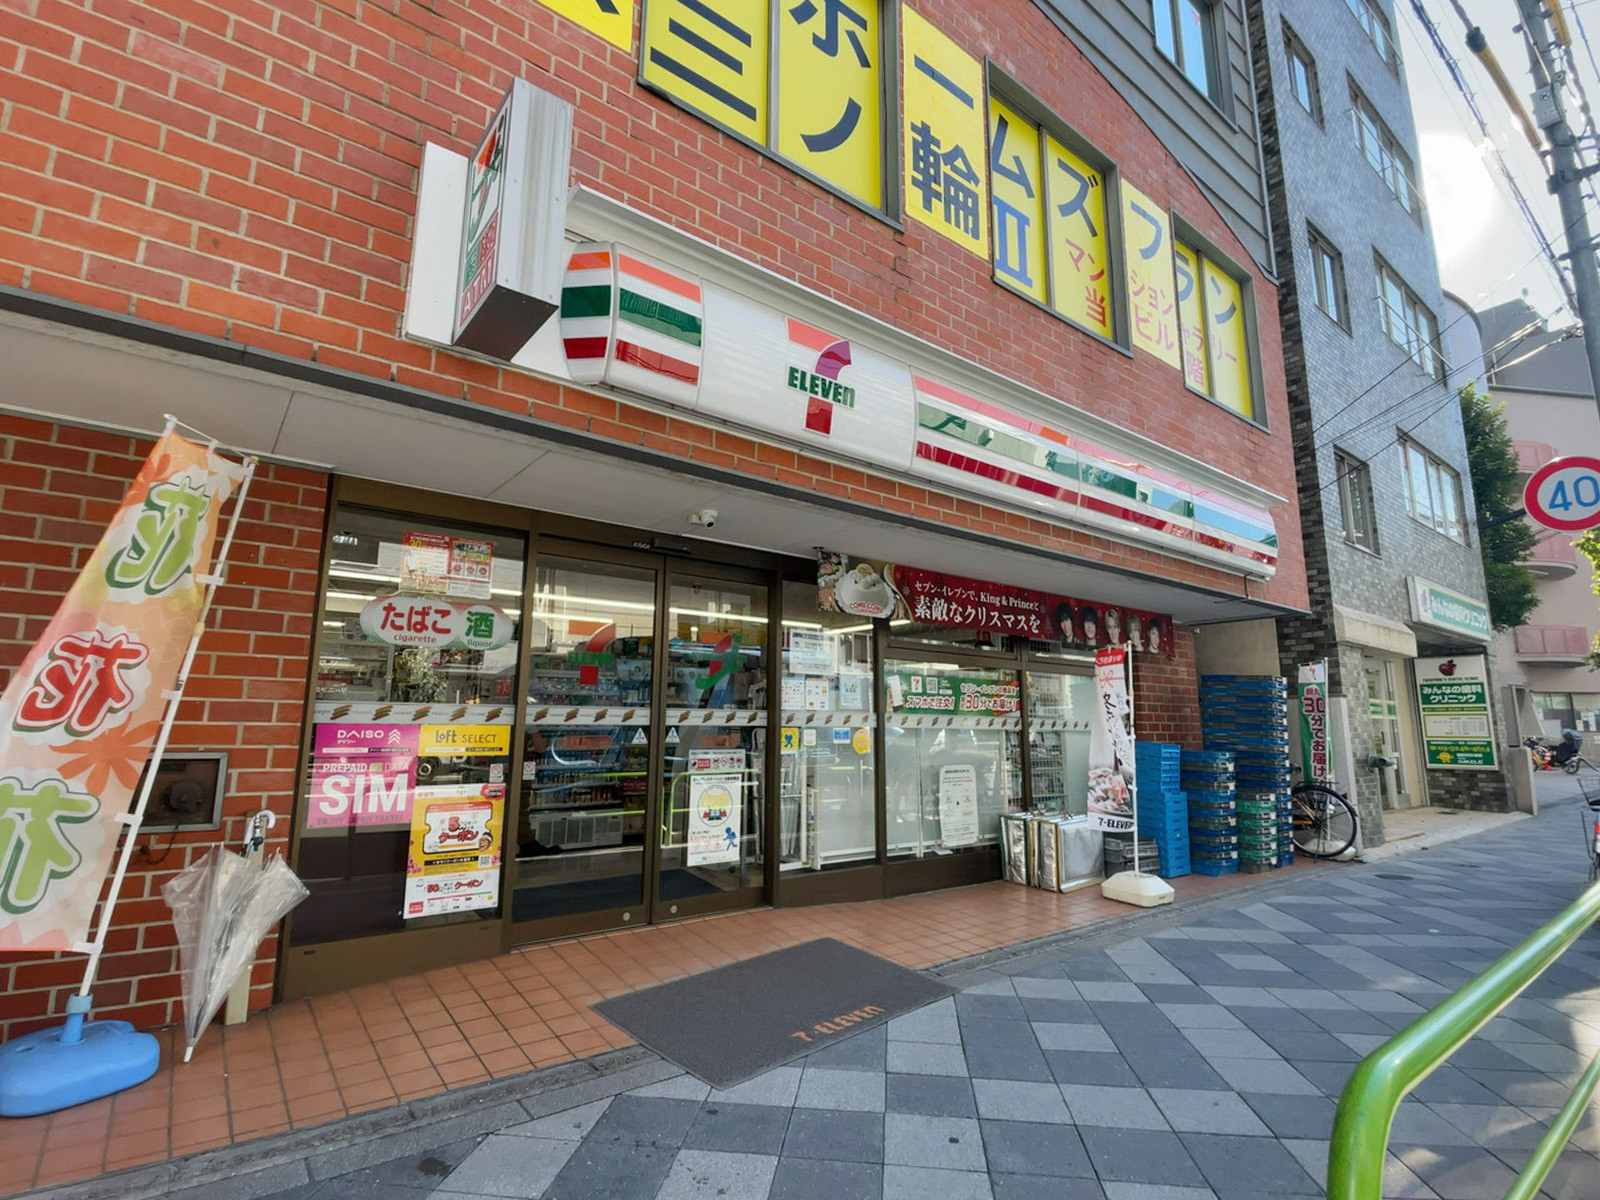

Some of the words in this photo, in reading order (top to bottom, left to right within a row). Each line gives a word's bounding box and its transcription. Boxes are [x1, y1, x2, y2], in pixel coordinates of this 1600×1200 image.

[1549, 476, 1600, 511] 40
[980, 592, 1001, 606] King
[1002, 596, 1008, 605] &
[914, 594, 1041, 634] 素敵なクリスマスを
[380, 602, 452, 634] たばこ
[465, 611, 495, 639] 酒
[393, 633, 437, 644] cigarette
[467, 639, 493, 648] liquor
[1422, 684, 1482, 694] みんなの歯科
[1429, 693, 1477, 703] クリニック
[337, 729, 385, 739] DAISO
[462, 734, 497, 743] SELECT
[322, 763, 367, 773] PREPAID
[319, 773, 409, 815] SIM
[317, 817, 343, 825] ENJOY
[349, 816, 373, 824] JAPAN
[375, 814, 403, 823] TRAVEL
